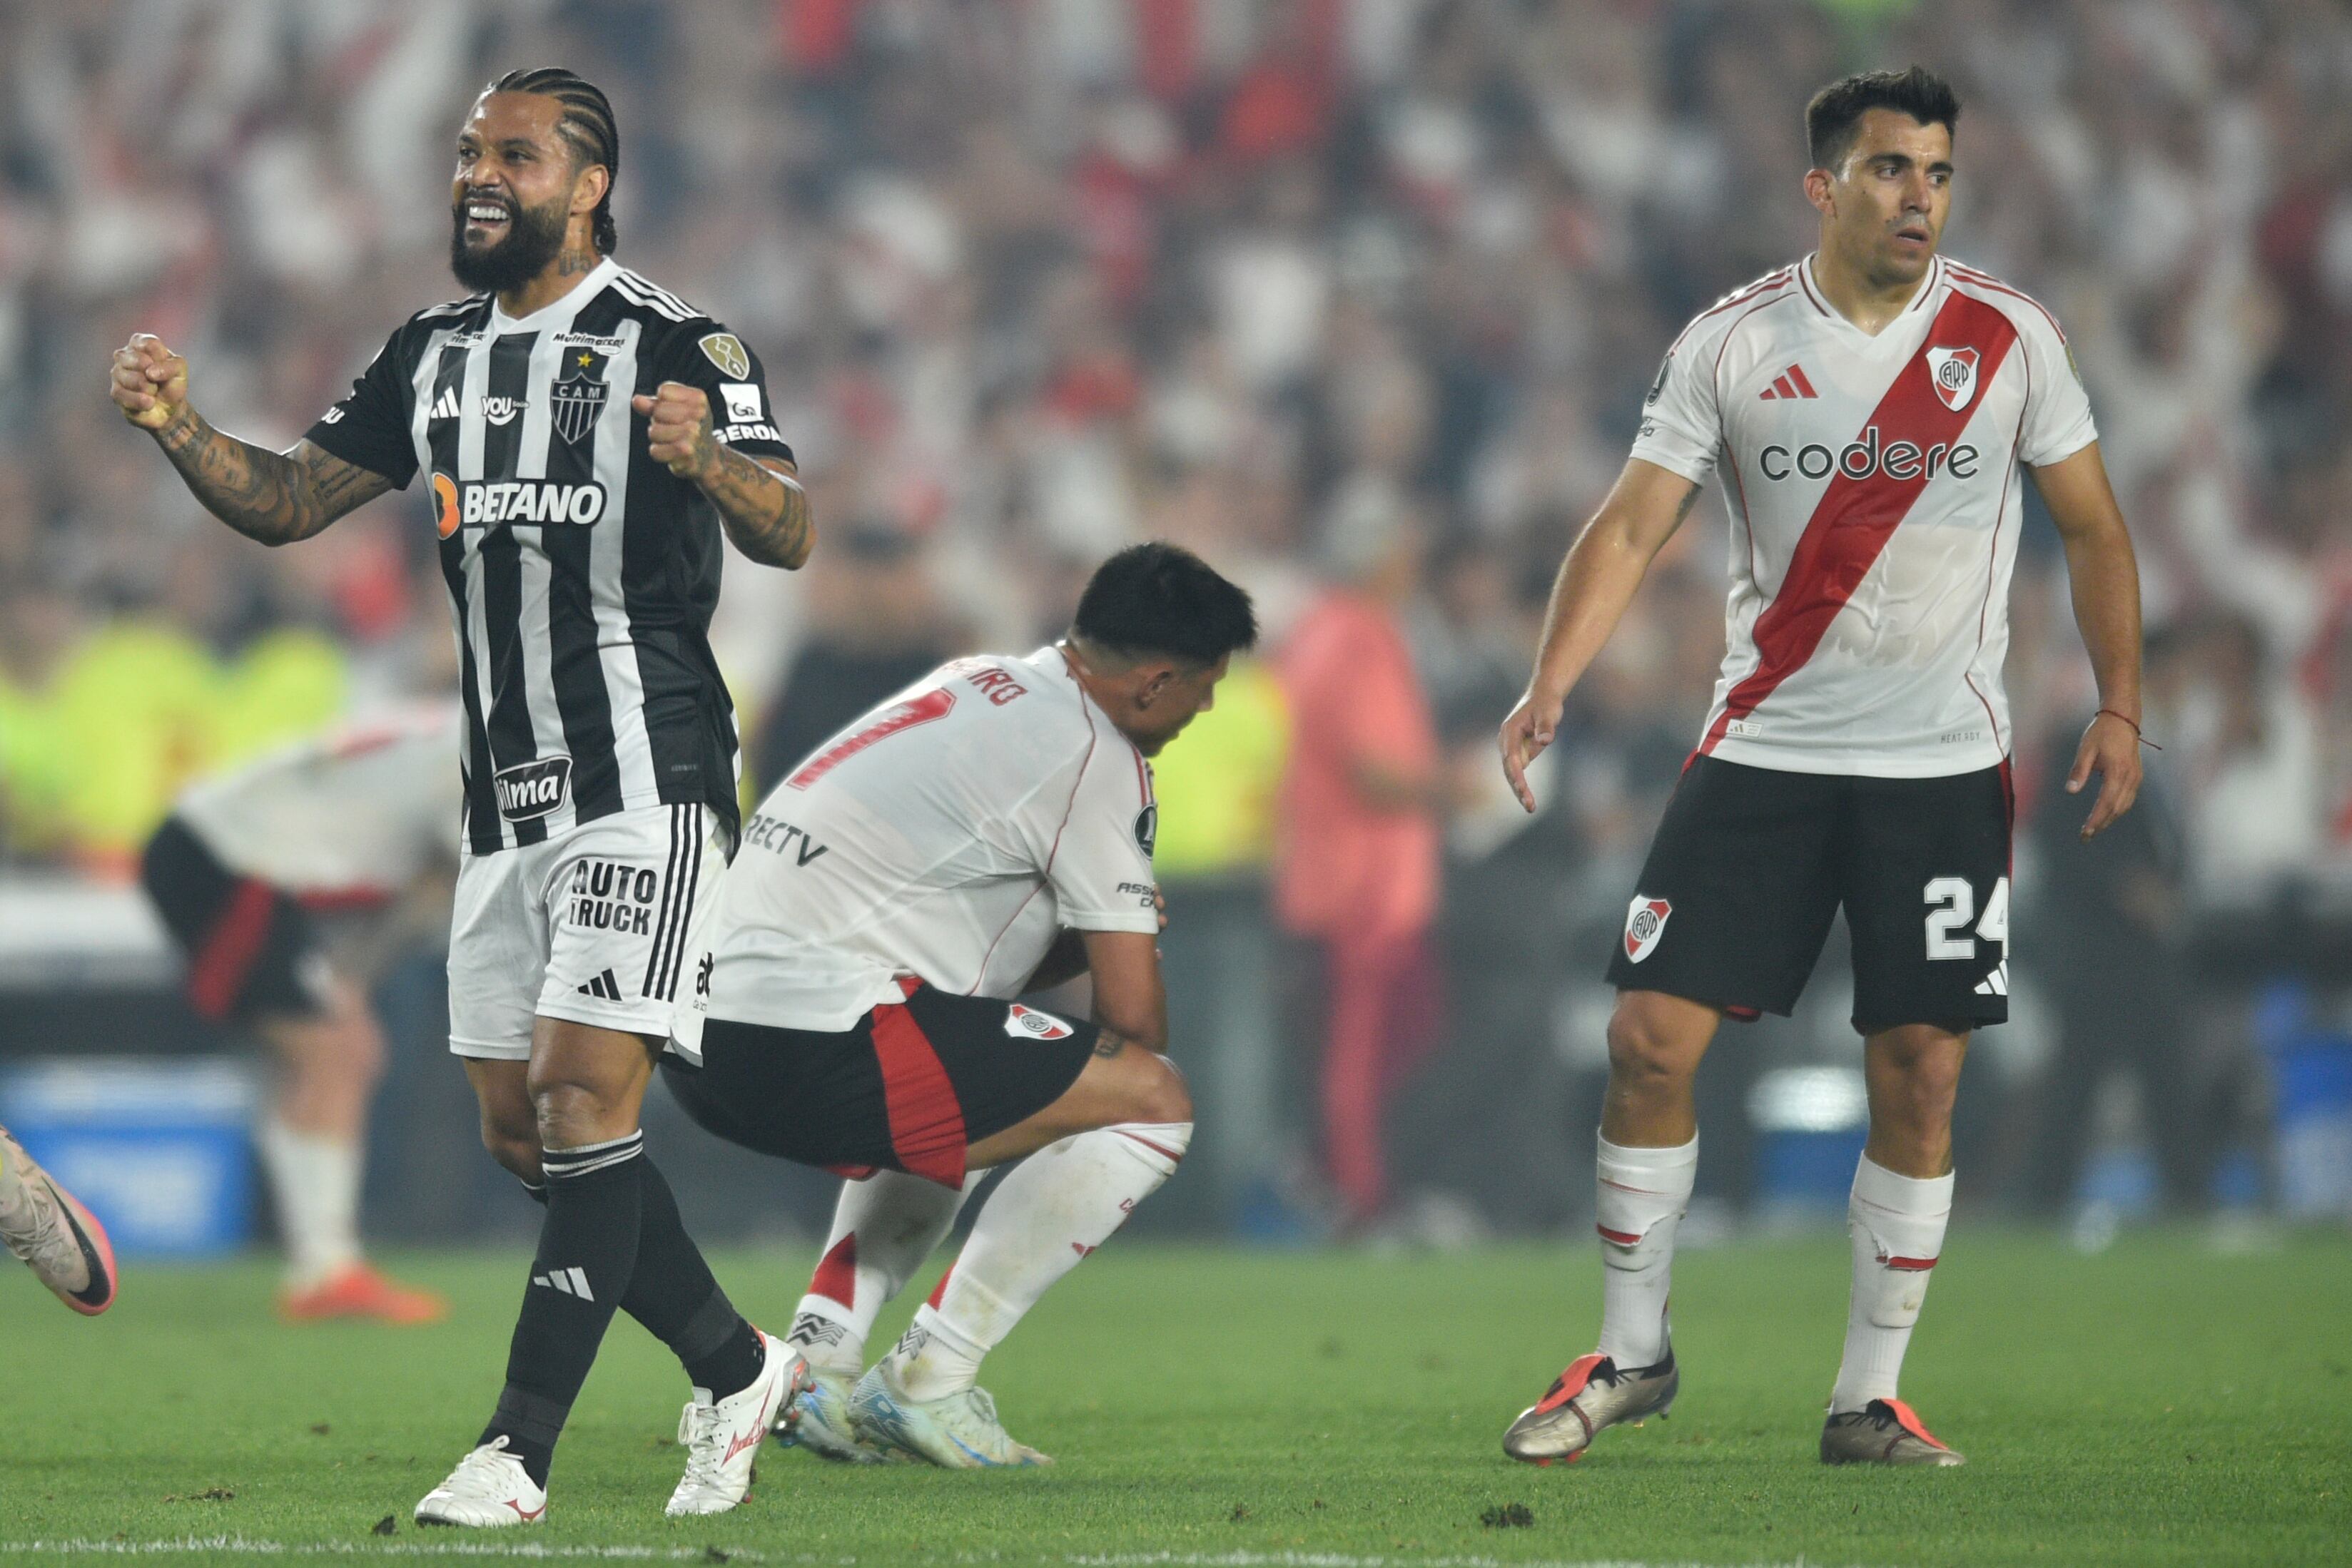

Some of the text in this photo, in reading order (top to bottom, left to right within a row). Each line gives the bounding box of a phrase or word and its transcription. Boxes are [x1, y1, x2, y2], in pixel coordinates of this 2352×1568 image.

[552, 333, 626, 347] Multimarcas
[558, 386, 601, 399] CAM
[1939, 360, 1969, 390] CARP
[482, 397, 512, 415] YOU
[1760, 427, 1980, 481] codere
[464, 483, 604, 525] BETANO
[572, 859, 657, 905] AUTO
[569, 897, 652, 936] TRUCK
[1924, 877, 2009, 960] 24
